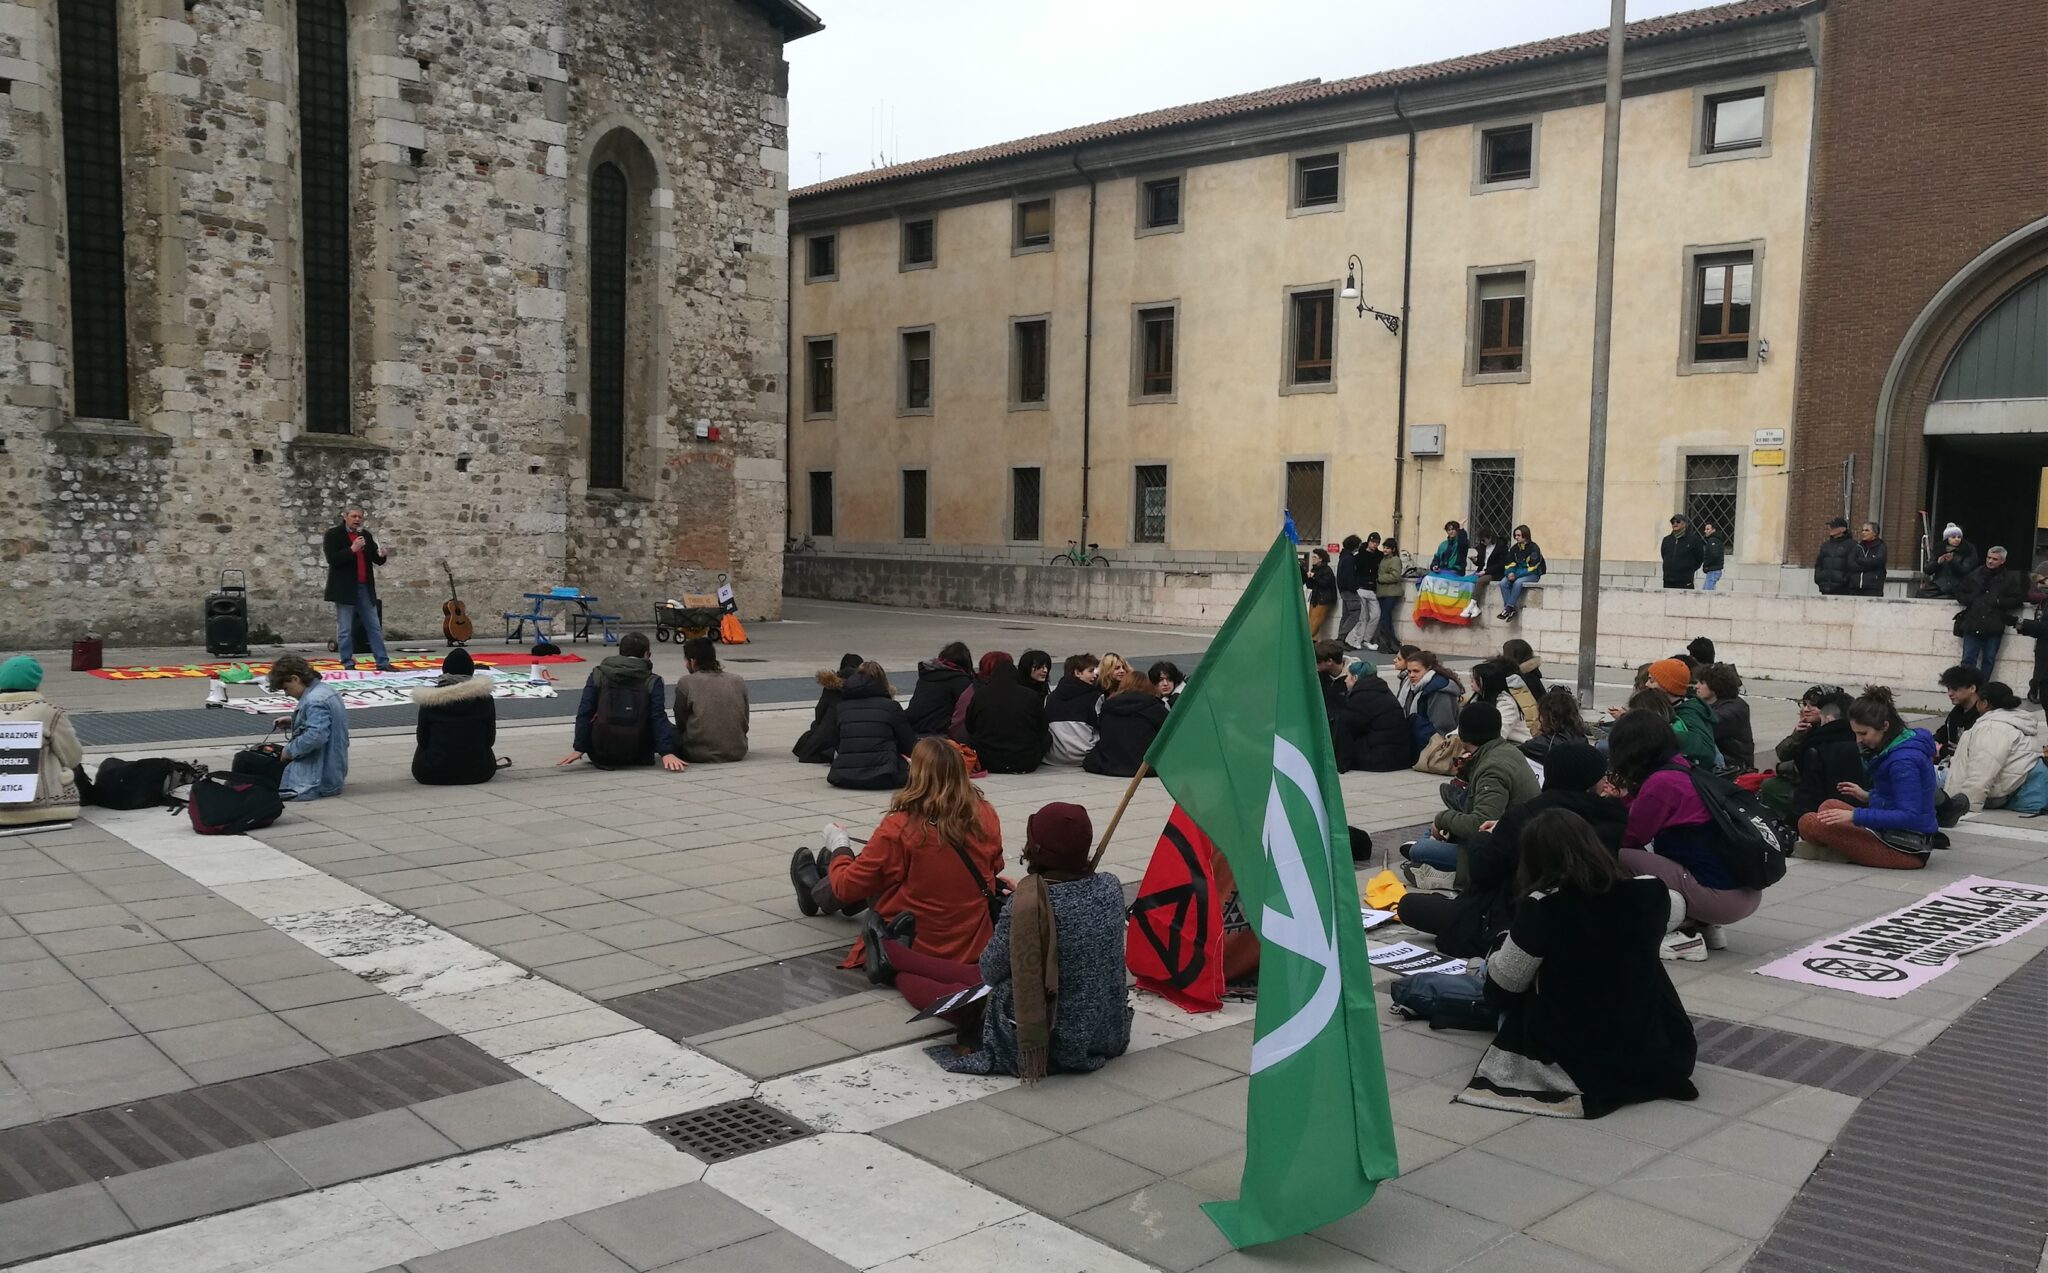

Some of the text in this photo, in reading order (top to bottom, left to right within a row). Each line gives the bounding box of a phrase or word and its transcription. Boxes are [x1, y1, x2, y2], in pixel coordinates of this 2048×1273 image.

[0, 784, 23, 792] ATICA
[1823, 895, 2012, 961] EMERGENZA
[1904, 936, 1984, 966] CLIMATICA
[1974, 905, 2047, 932] ECOLOGICA
